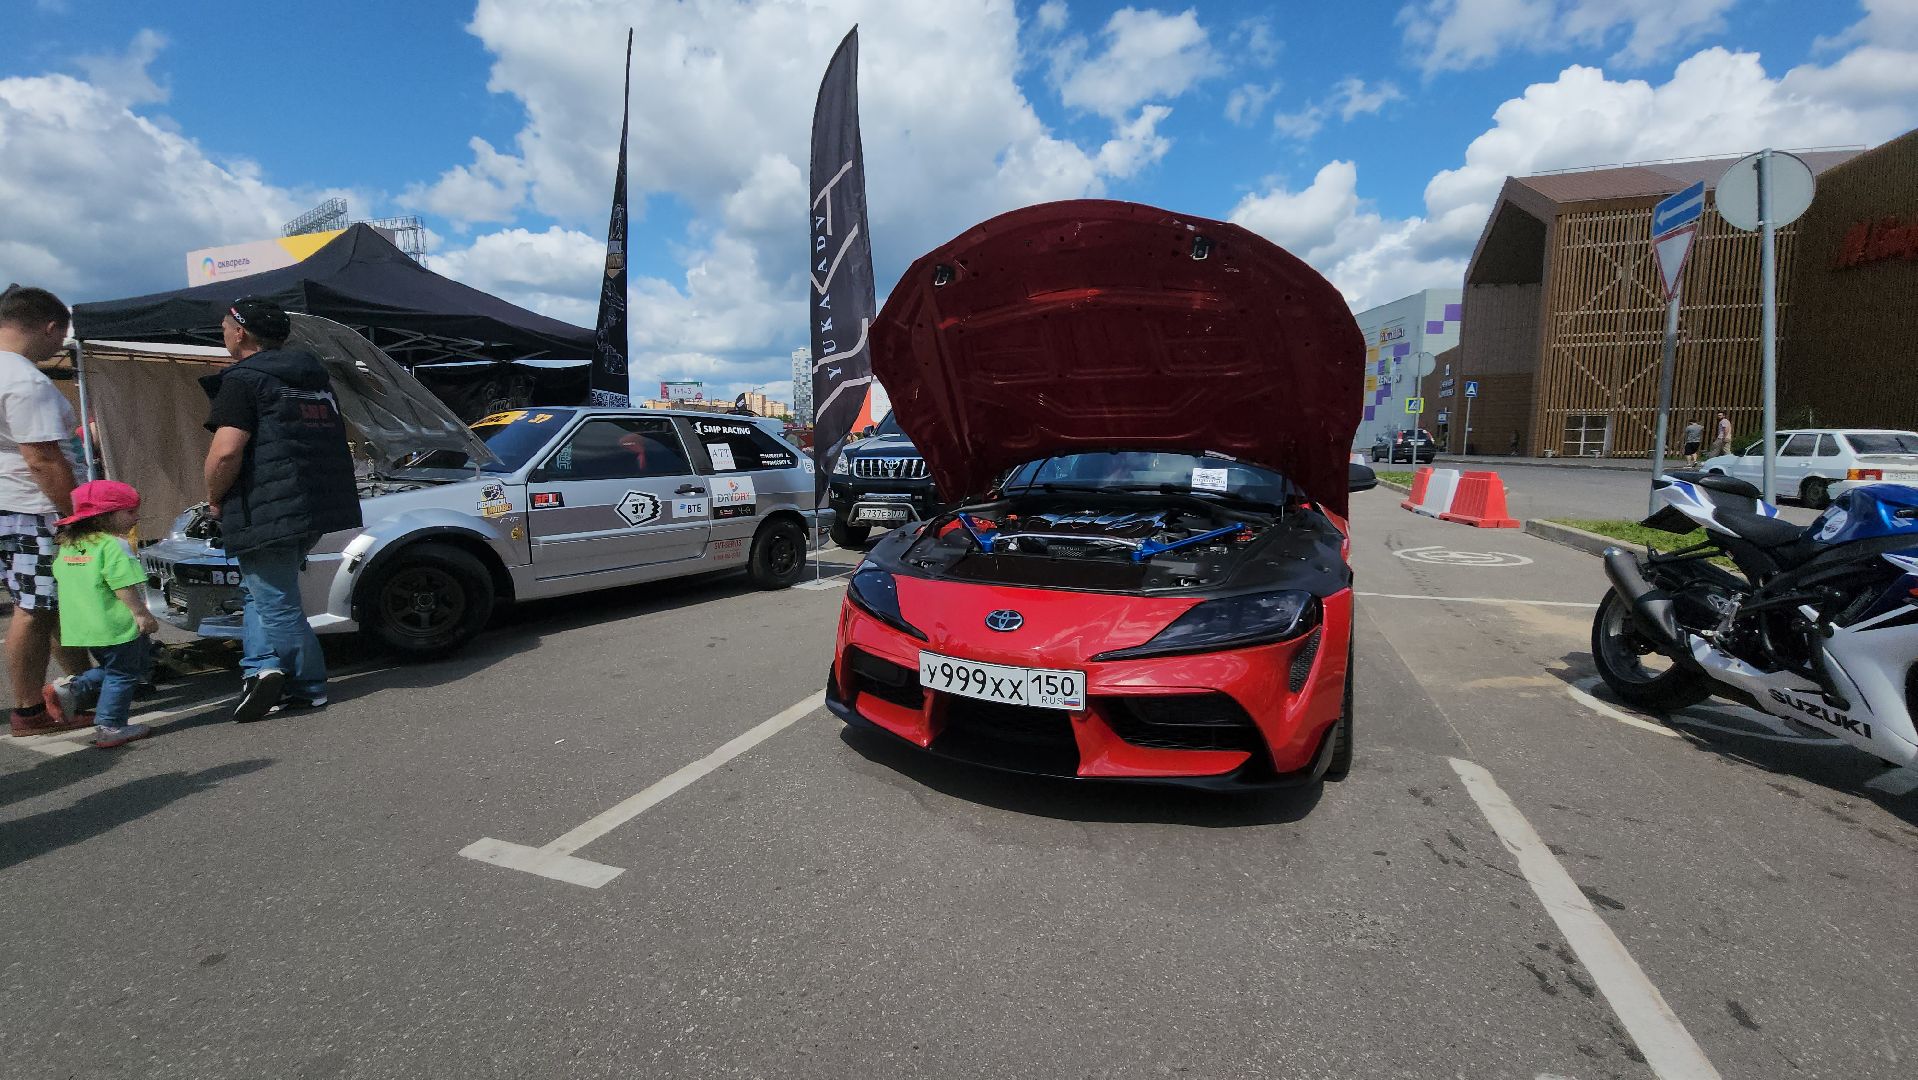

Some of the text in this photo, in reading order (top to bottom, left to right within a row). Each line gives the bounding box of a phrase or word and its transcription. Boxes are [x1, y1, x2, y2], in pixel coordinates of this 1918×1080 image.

[703, 425, 751, 435] SMP RACING
[631, 503, 646, 514] 37
[1031, 674, 1075, 697] 150
[1041, 695, 1064, 705] RUS
[1768, 688, 1872, 739] SUZUKI
